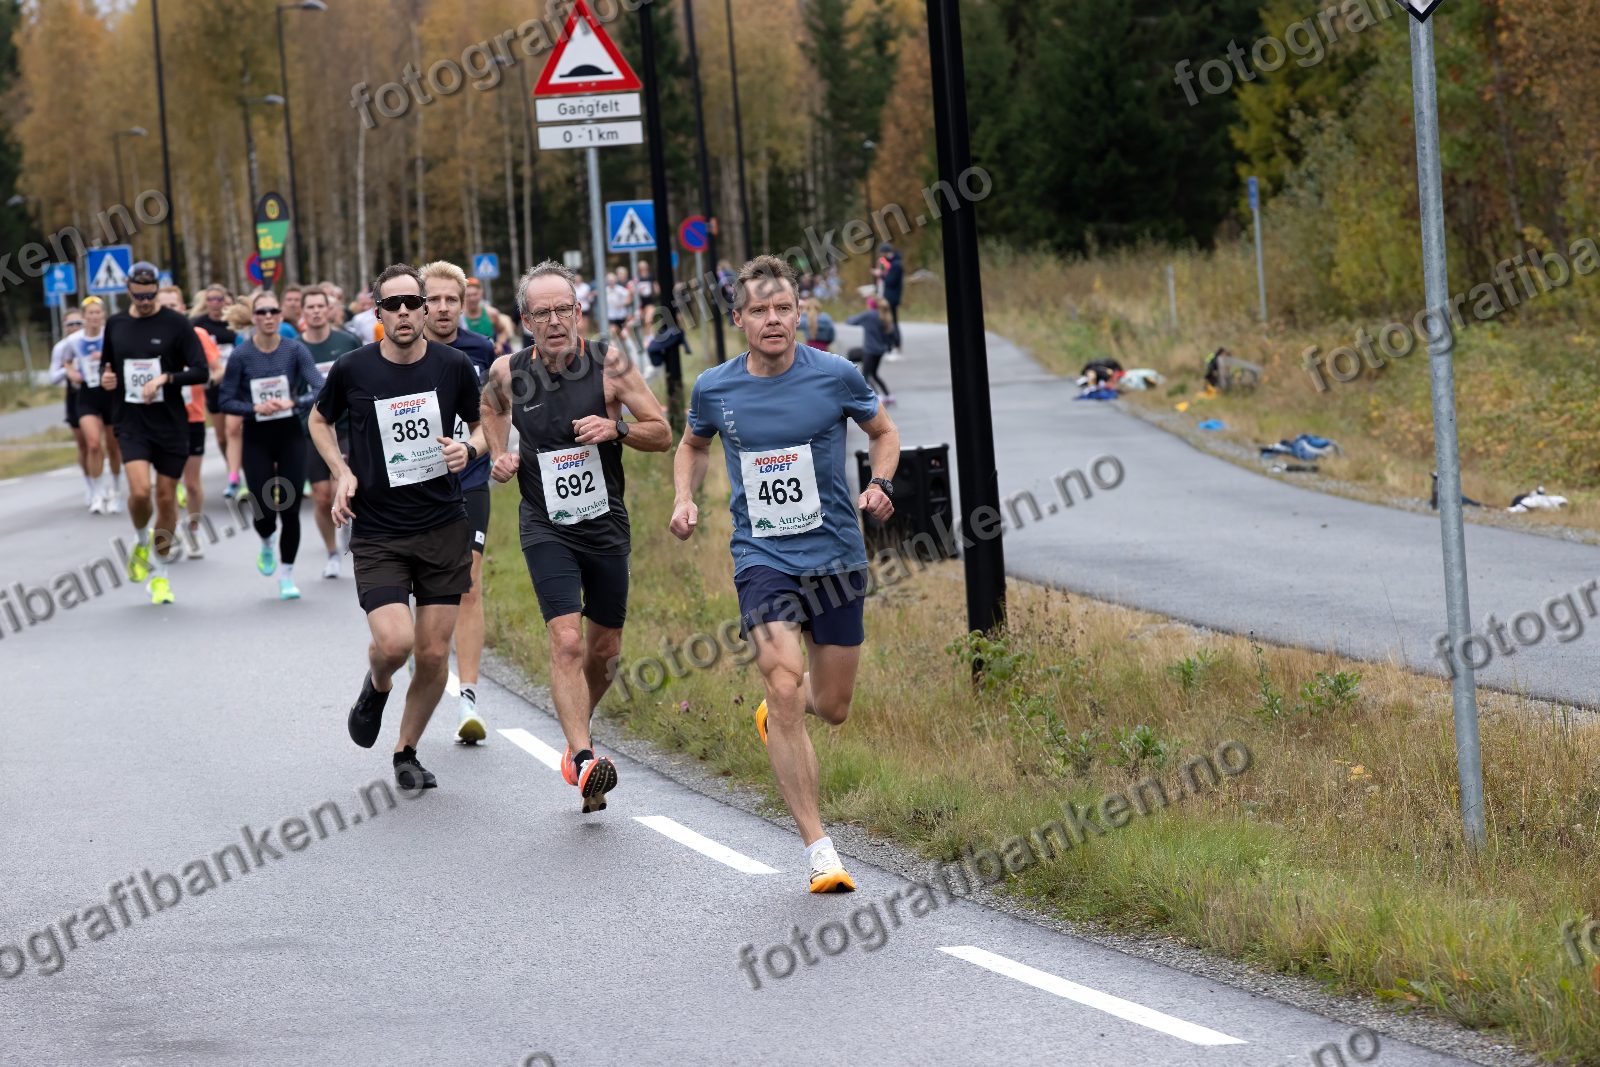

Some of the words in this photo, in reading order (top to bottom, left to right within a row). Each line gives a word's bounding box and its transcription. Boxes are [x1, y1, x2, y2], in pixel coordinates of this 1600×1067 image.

[558, 100, 620, 117] Gangfelt
[390, 397, 426, 410] NORGES
[394, 406, 421, 416] LØPET
[392, 418, 430, 442] 383
[552, 450, 590, 464] NORGES
[754, 453, 798, 466] NORGES
[557, 459, 586, 470] LØPET
[759, 462, 792, 474] LØPET
[555, 470, 595, 499] 692
[758, 477, 803, 505] 463
[576, 498, 607, 514] Aurskog
